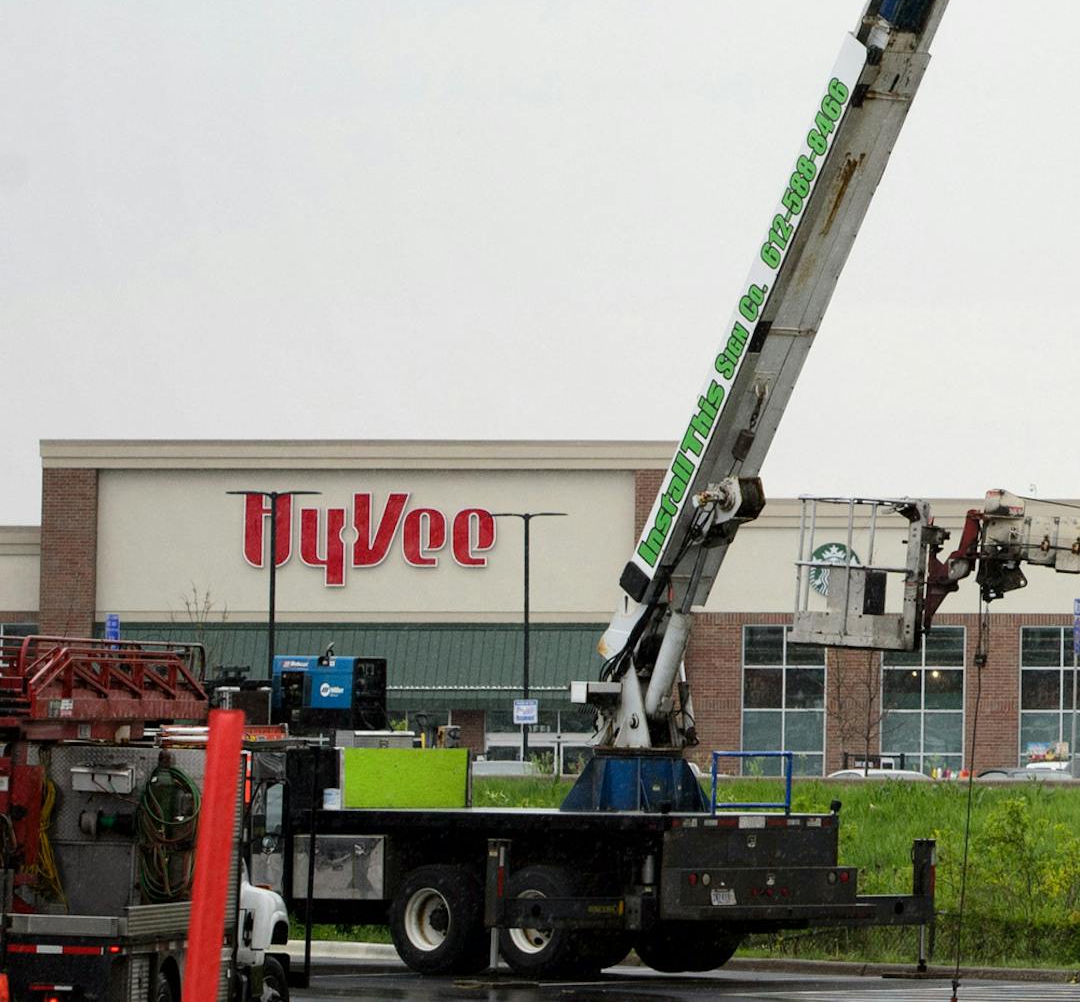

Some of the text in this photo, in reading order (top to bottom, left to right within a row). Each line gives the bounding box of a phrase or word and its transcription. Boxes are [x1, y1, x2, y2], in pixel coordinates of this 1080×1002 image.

[637, 451, 695, 568] Install
[681, 379, 725, 458] This
[760, 78, 849, 270] 612-588-8466
